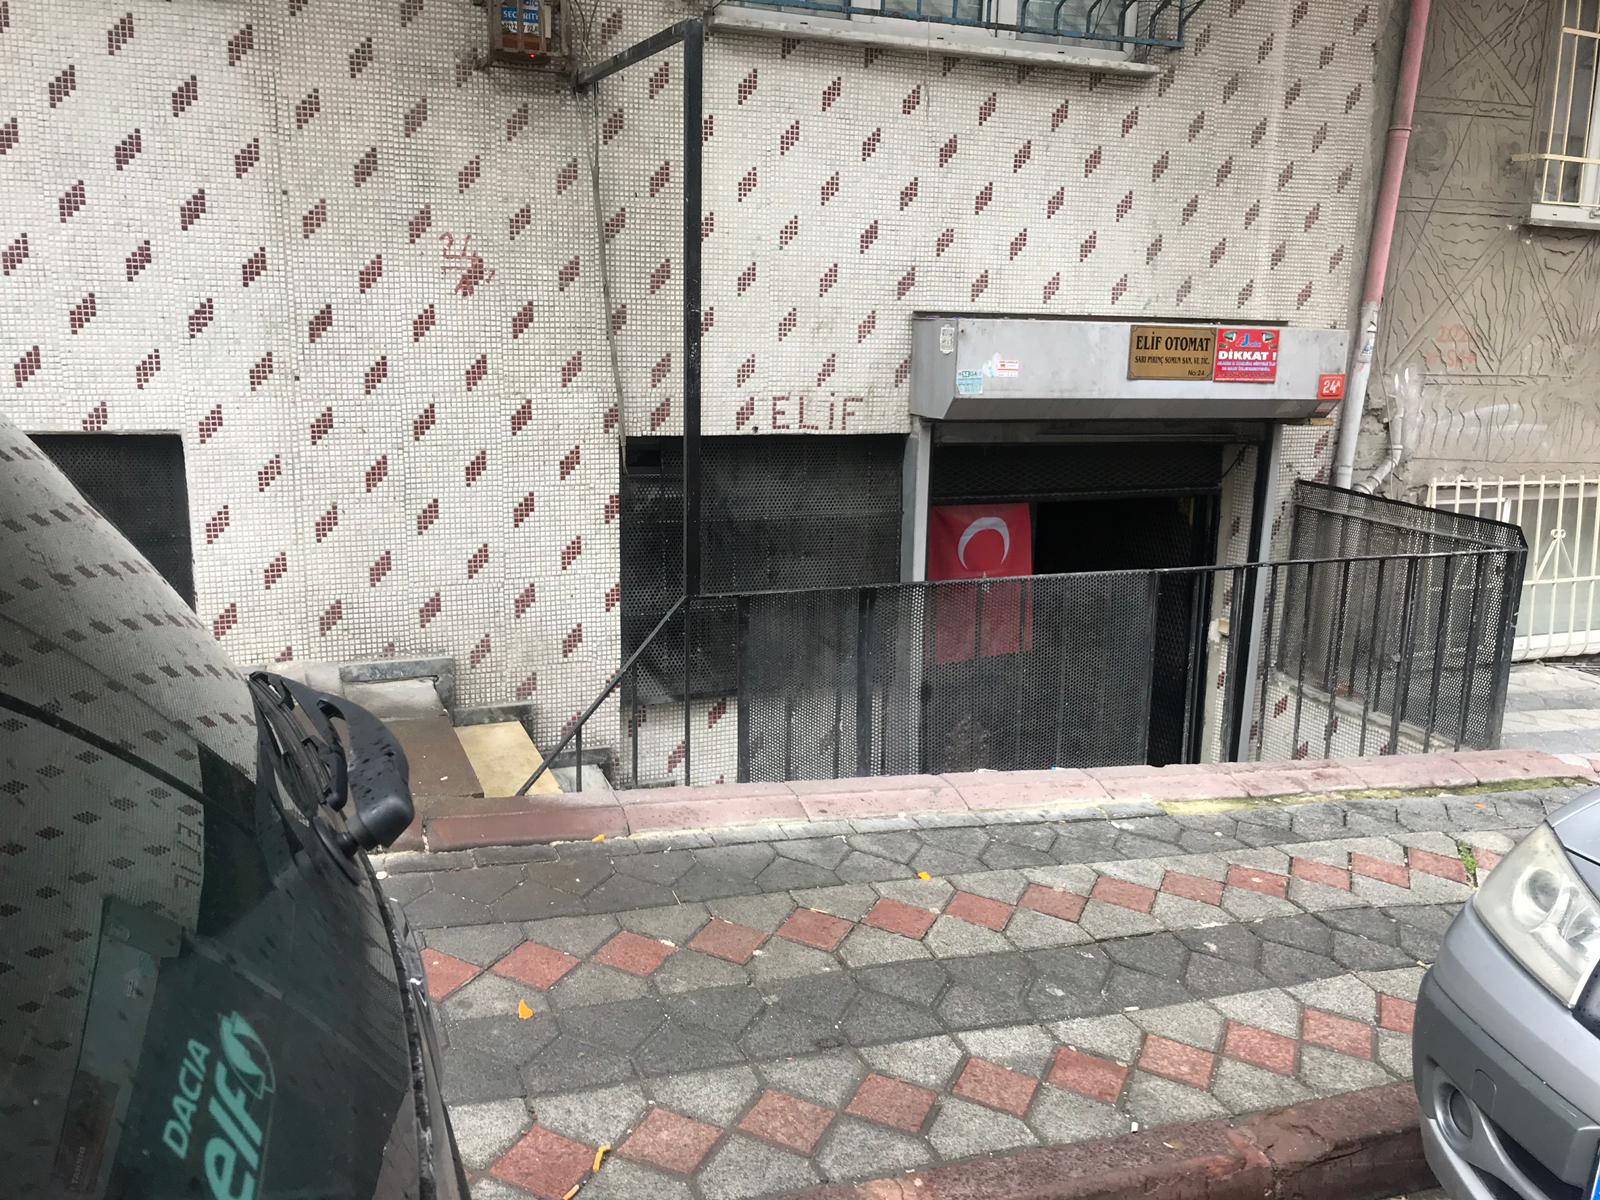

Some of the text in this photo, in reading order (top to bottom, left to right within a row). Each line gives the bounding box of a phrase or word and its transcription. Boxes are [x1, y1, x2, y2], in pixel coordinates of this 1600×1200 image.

[503, 10, 539, 20] SECRITY
[1136, 332, 1211, 351] ELİF OTOMAT
[1218, 349, 1269, 360] DİKKAT
[772, 392, 863, 430] ELİF
[163, 1039, 211, 1160] DACIA
[204, 1061, 263, 1200] elf
